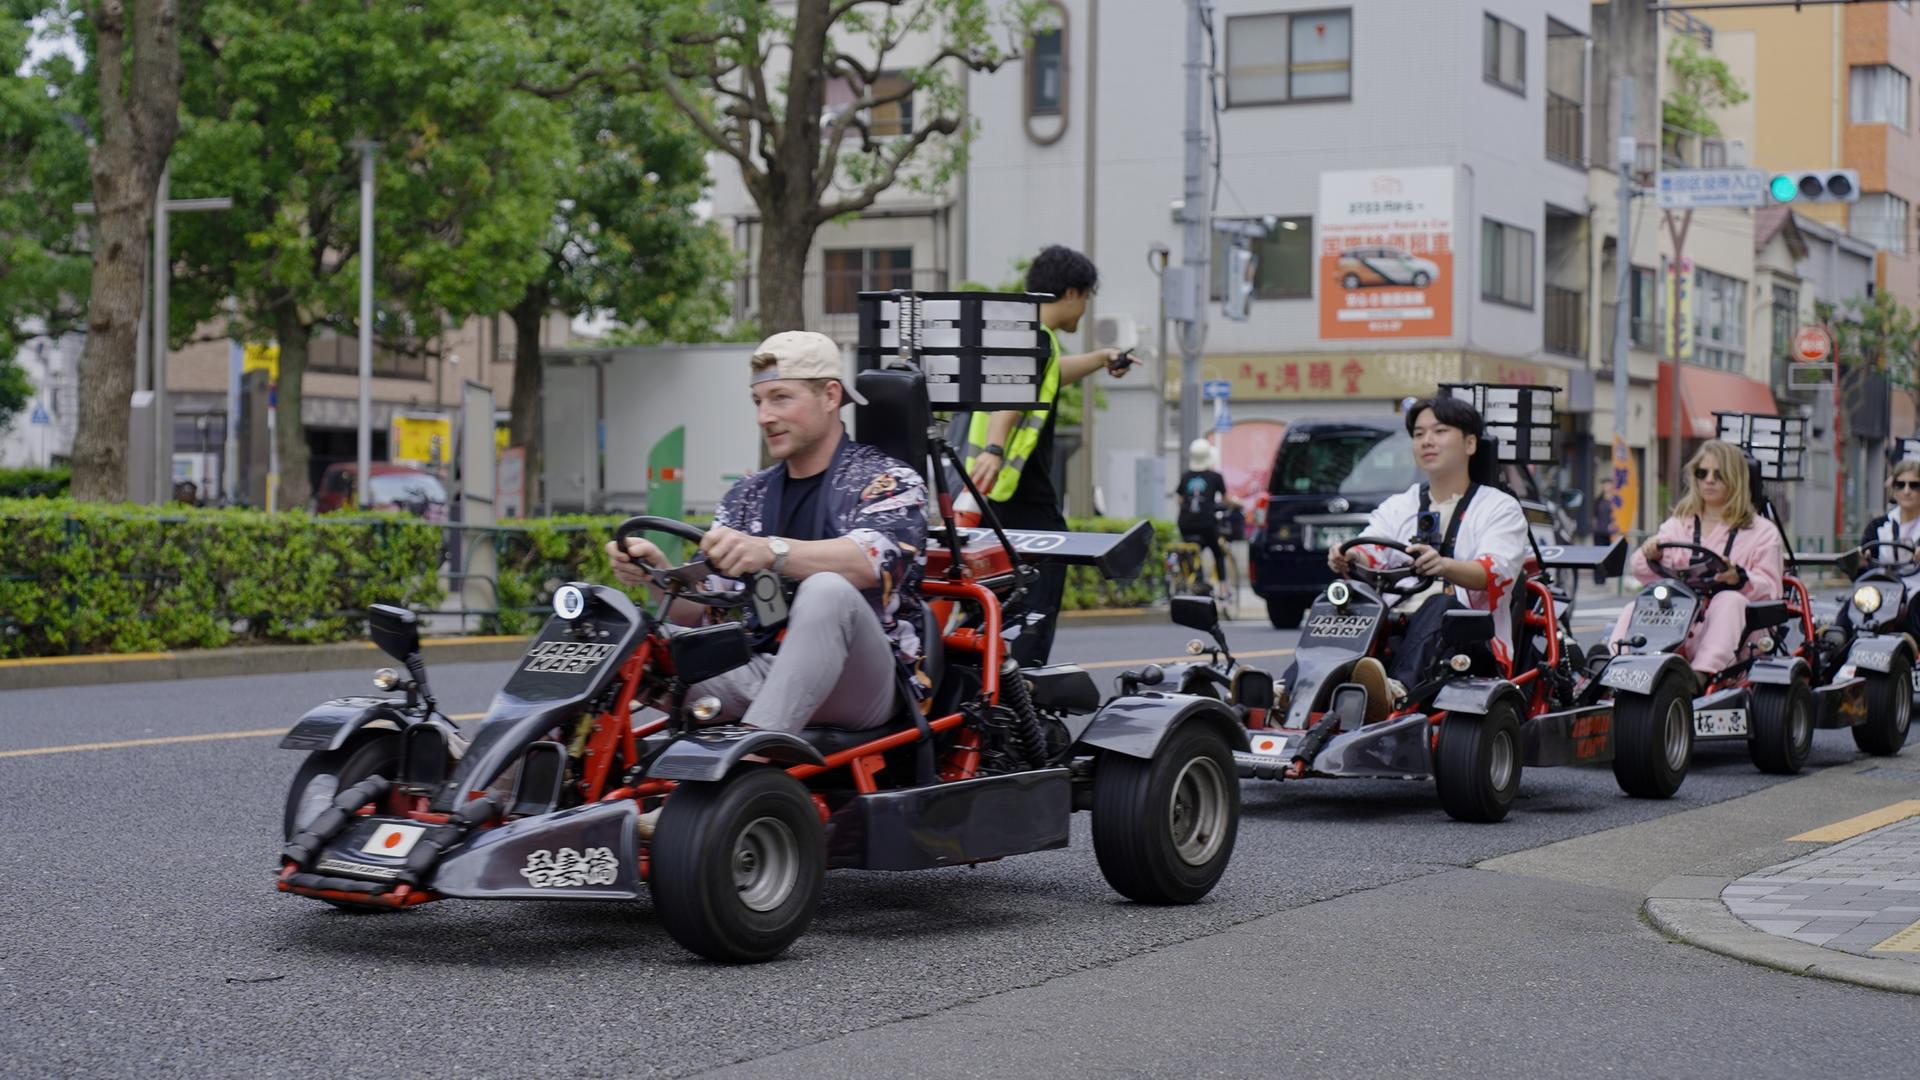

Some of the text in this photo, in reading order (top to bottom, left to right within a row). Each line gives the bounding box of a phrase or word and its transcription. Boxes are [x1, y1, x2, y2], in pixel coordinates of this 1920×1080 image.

[1309, 615, 1377, 629] JAPAN
[1310, 626, 1366, 638] KART
[527, 641, 618, 660] JAPAN
[524, 656, 602, 674] KART
